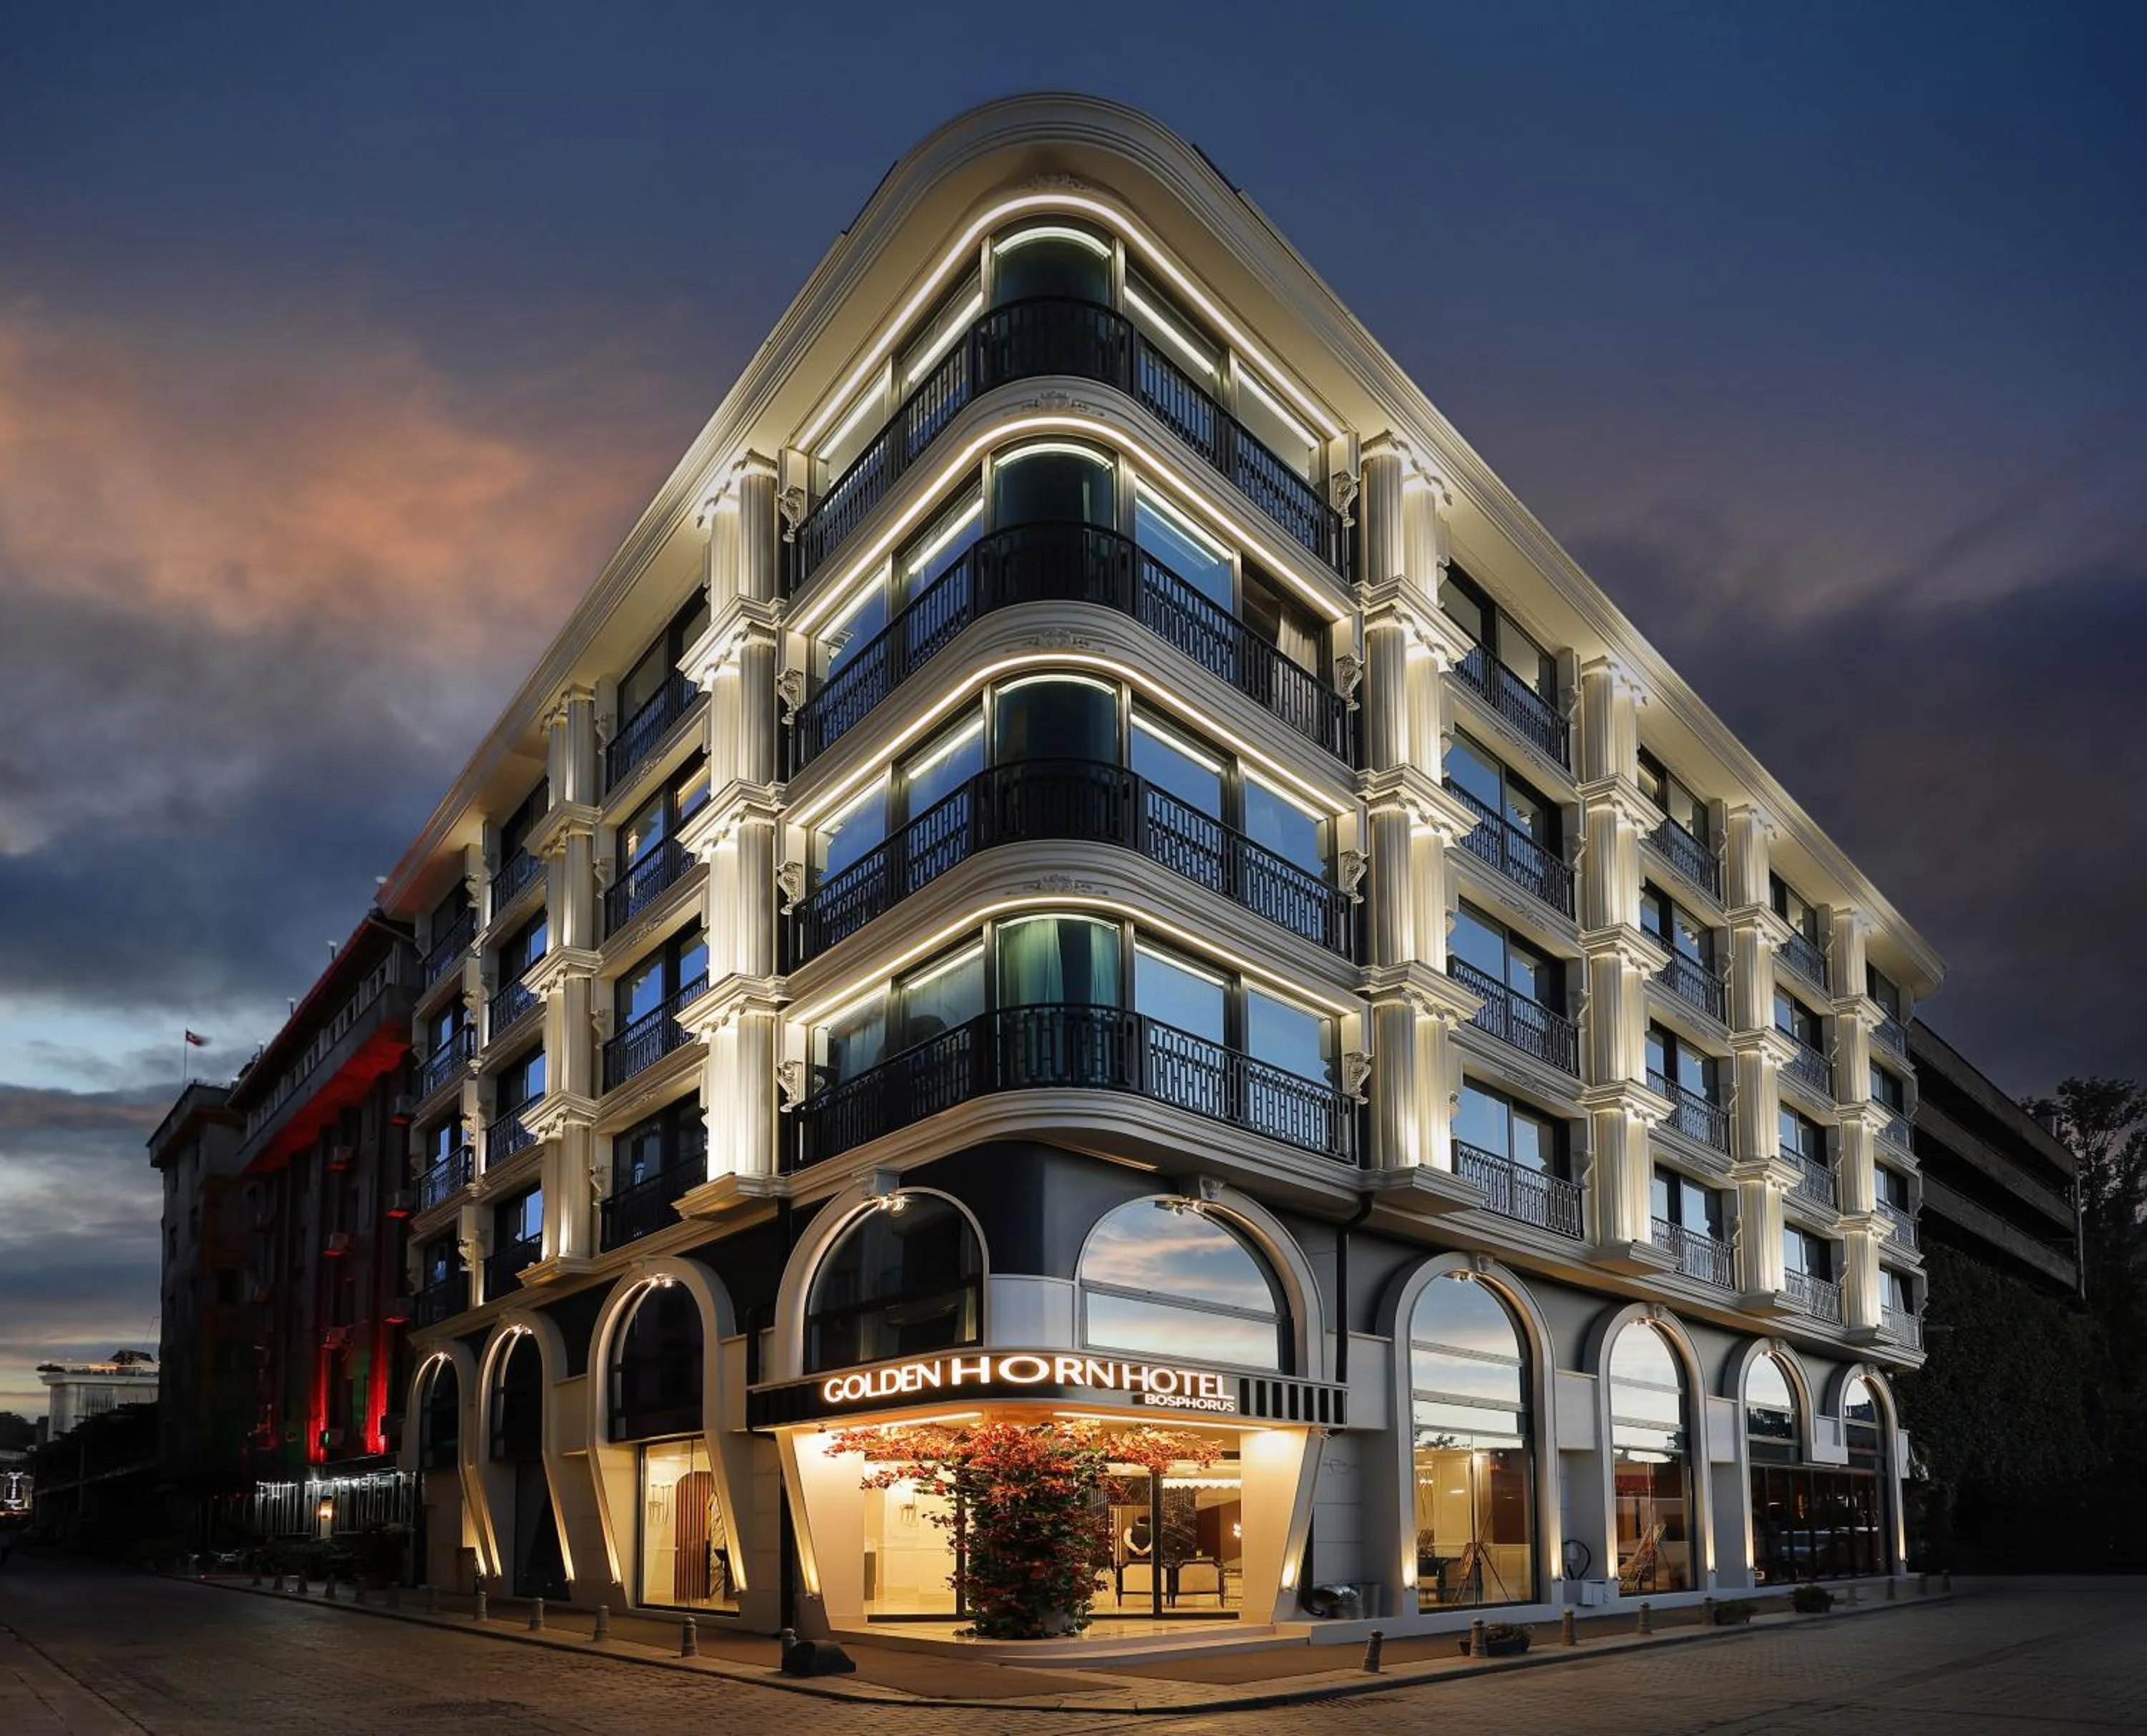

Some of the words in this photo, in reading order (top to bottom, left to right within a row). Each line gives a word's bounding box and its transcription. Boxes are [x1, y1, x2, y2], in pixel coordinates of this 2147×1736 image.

[824, 1360, 941, 1403] GOLDEN
[951, 1356, 1114, 1388] HORN
[1122, 1363, 1235, 1400] HOTEL
[1145, 1394, 1235, 1413] BOSPHORUS
